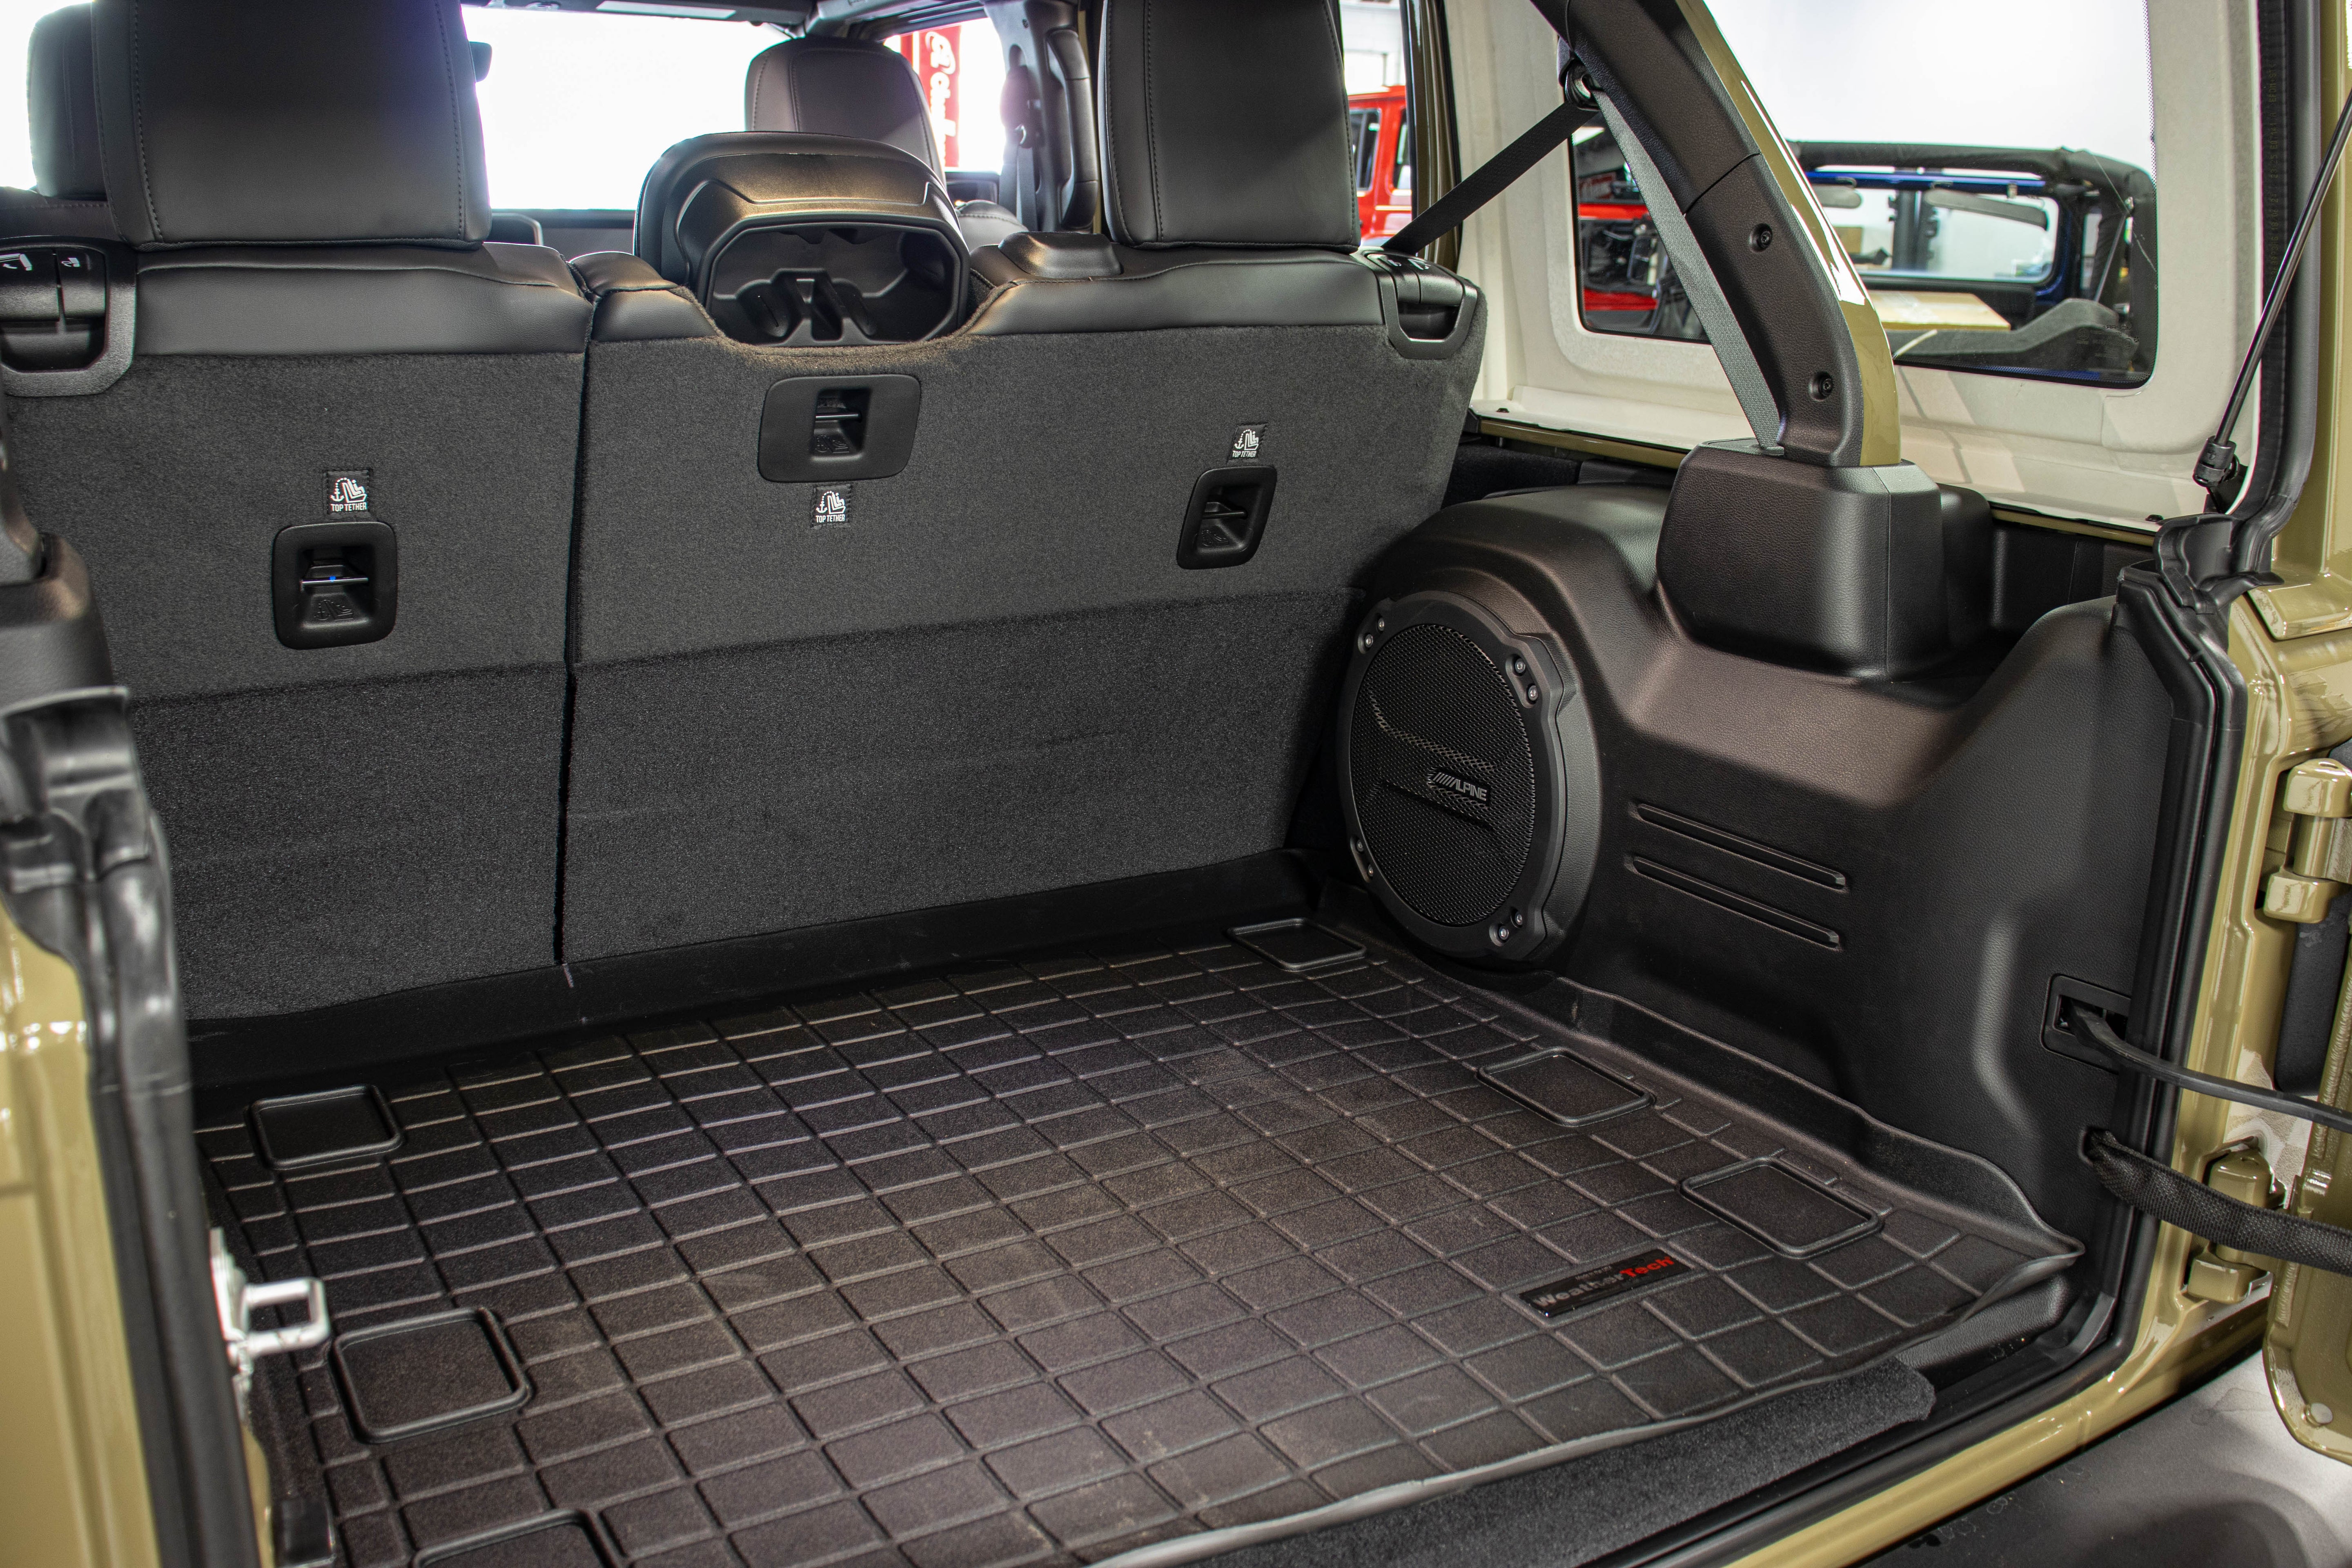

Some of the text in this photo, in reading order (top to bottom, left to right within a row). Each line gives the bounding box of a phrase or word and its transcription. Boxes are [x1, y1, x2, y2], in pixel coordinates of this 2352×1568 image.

[331, 502, 367, 512] TOP TETHER
[827, 514, 845, 522] TETHER
[1433, 772, 1487, 801] ALPINE
[1532, 1256, 1675, 1307] WeatherTech
